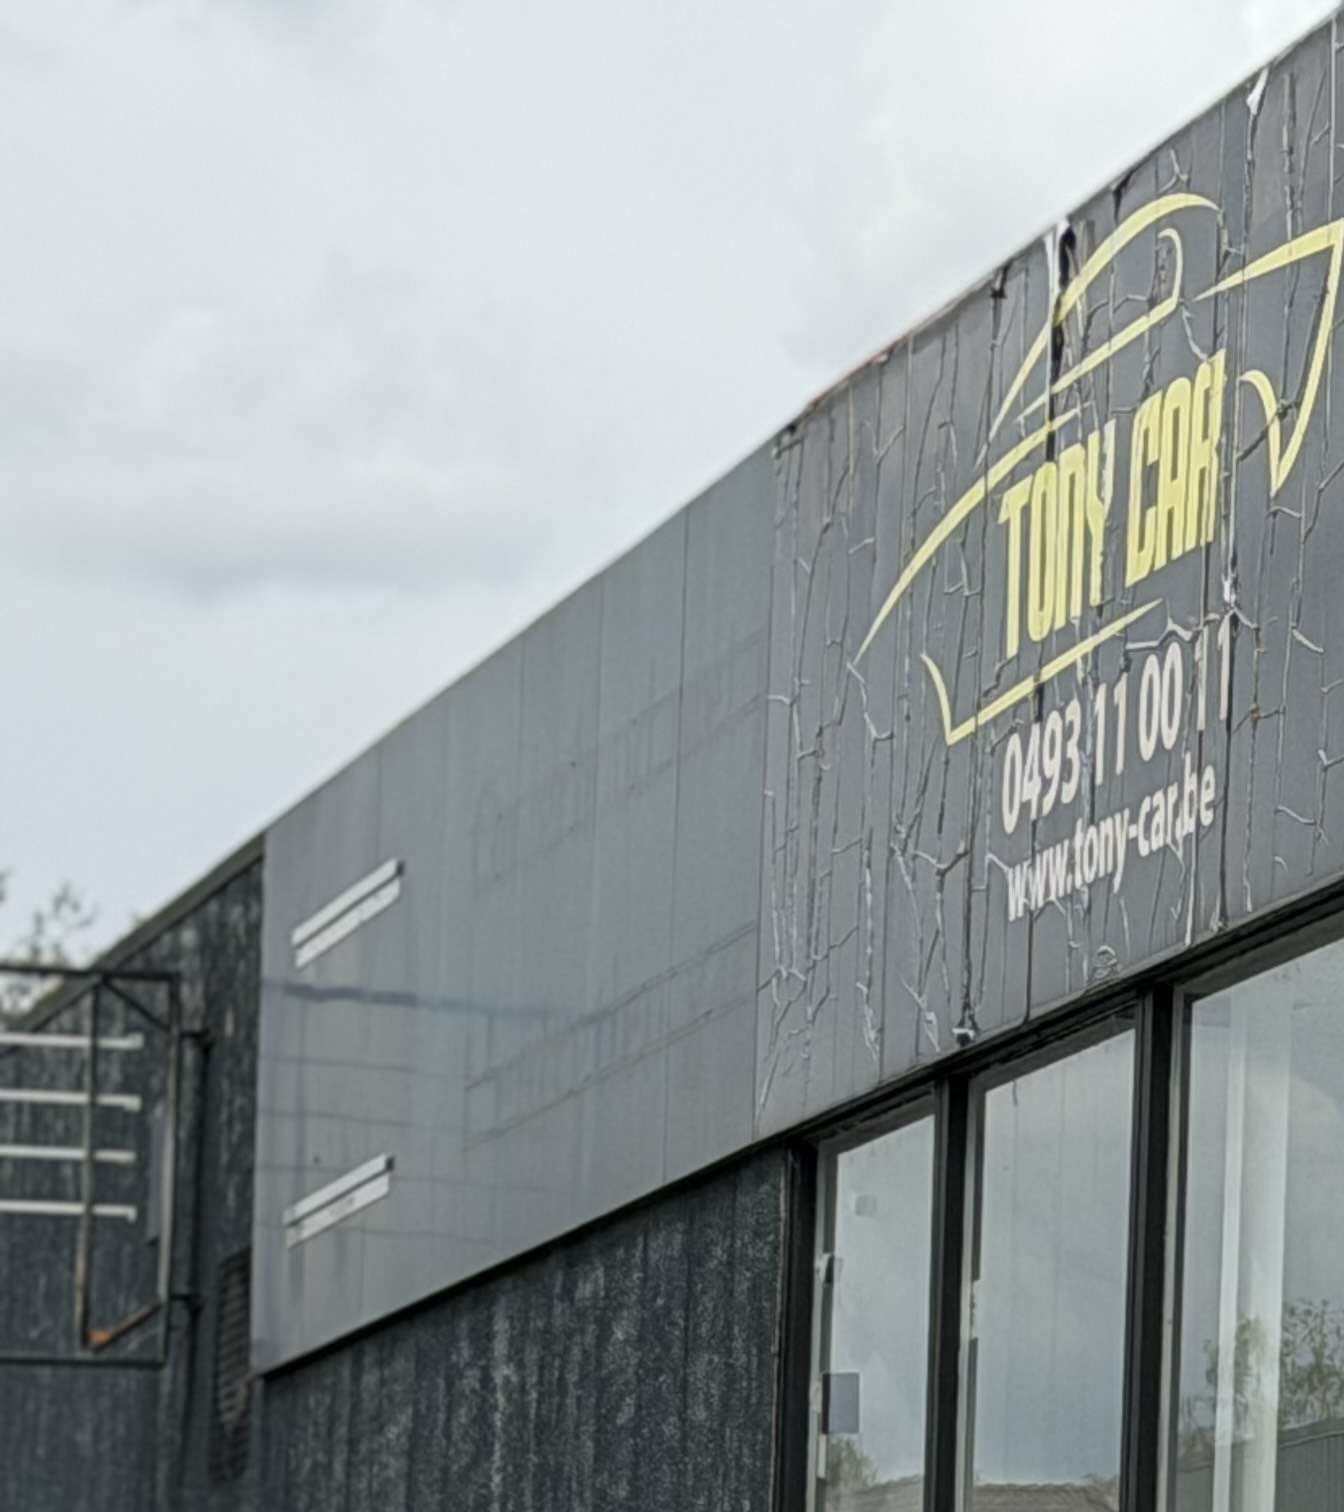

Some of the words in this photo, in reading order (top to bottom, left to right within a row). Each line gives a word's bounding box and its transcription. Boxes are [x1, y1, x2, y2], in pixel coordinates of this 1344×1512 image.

[998, 418, 1116, 658] TONY
[1125, 349, 1226, 588] CAR
[1002, 699, 1081, 835] 0493
[1138, 641, 1183, 761] 00
[1007, 751, 1216, 922] www.tony-car.be
